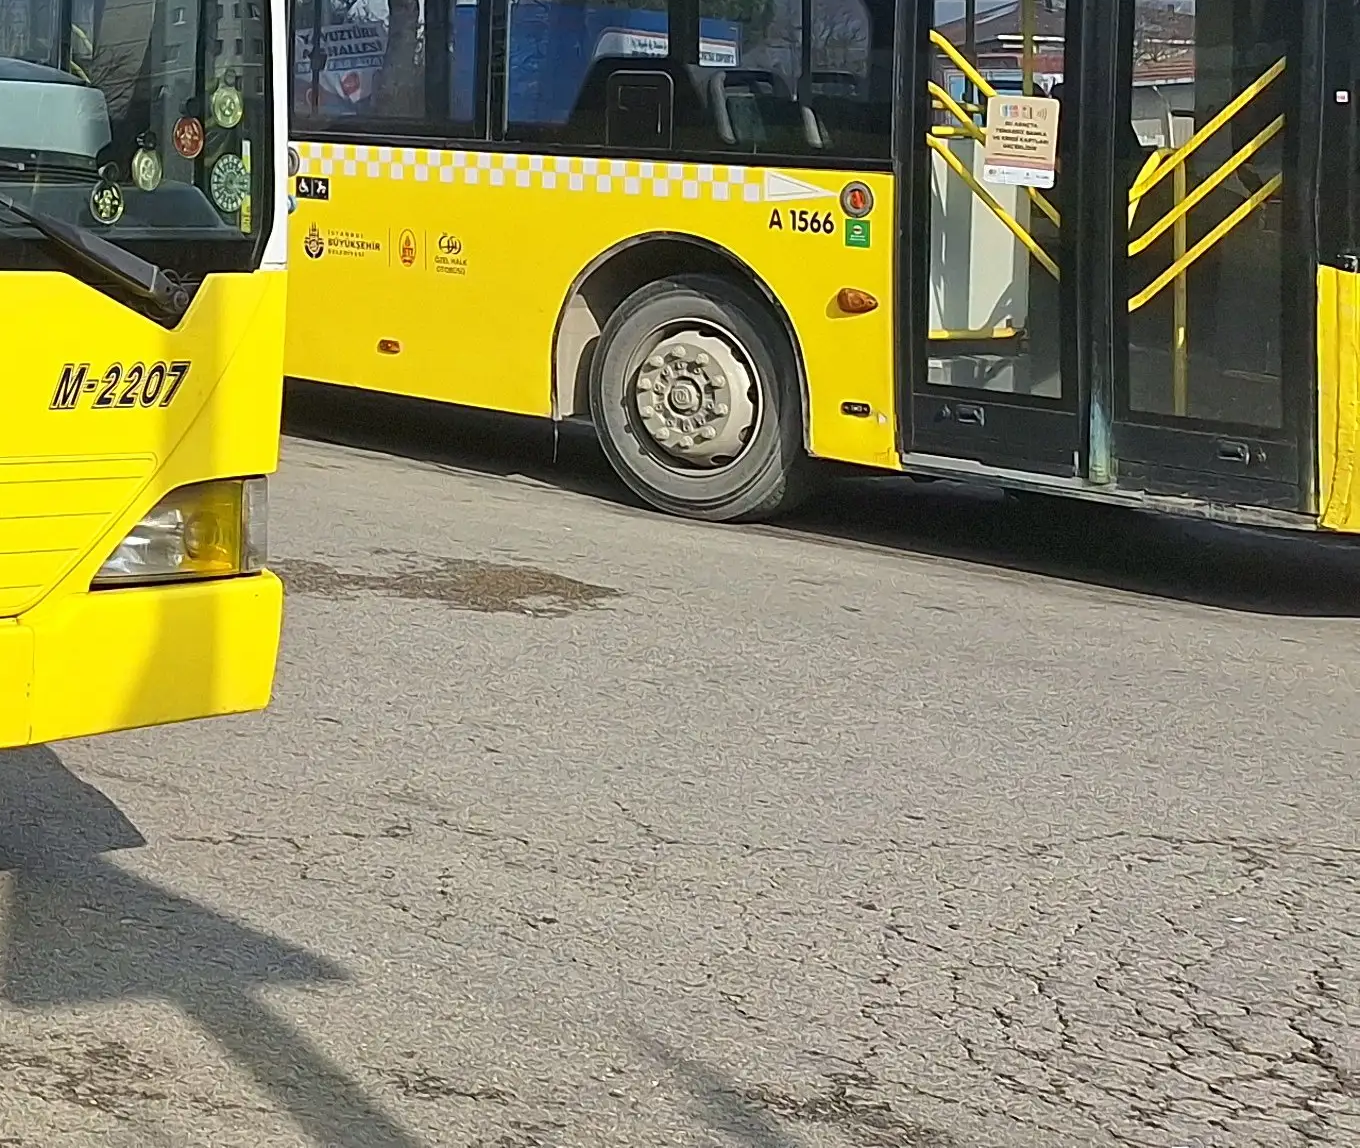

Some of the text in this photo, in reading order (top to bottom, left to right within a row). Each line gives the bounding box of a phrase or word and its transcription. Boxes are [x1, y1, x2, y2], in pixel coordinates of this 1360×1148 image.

[769, 208, 834, 234] A 1566
[327, 237, 381, 252] BÜYÜKŞEHİR
[49, 361, 191, 410] M-2207
